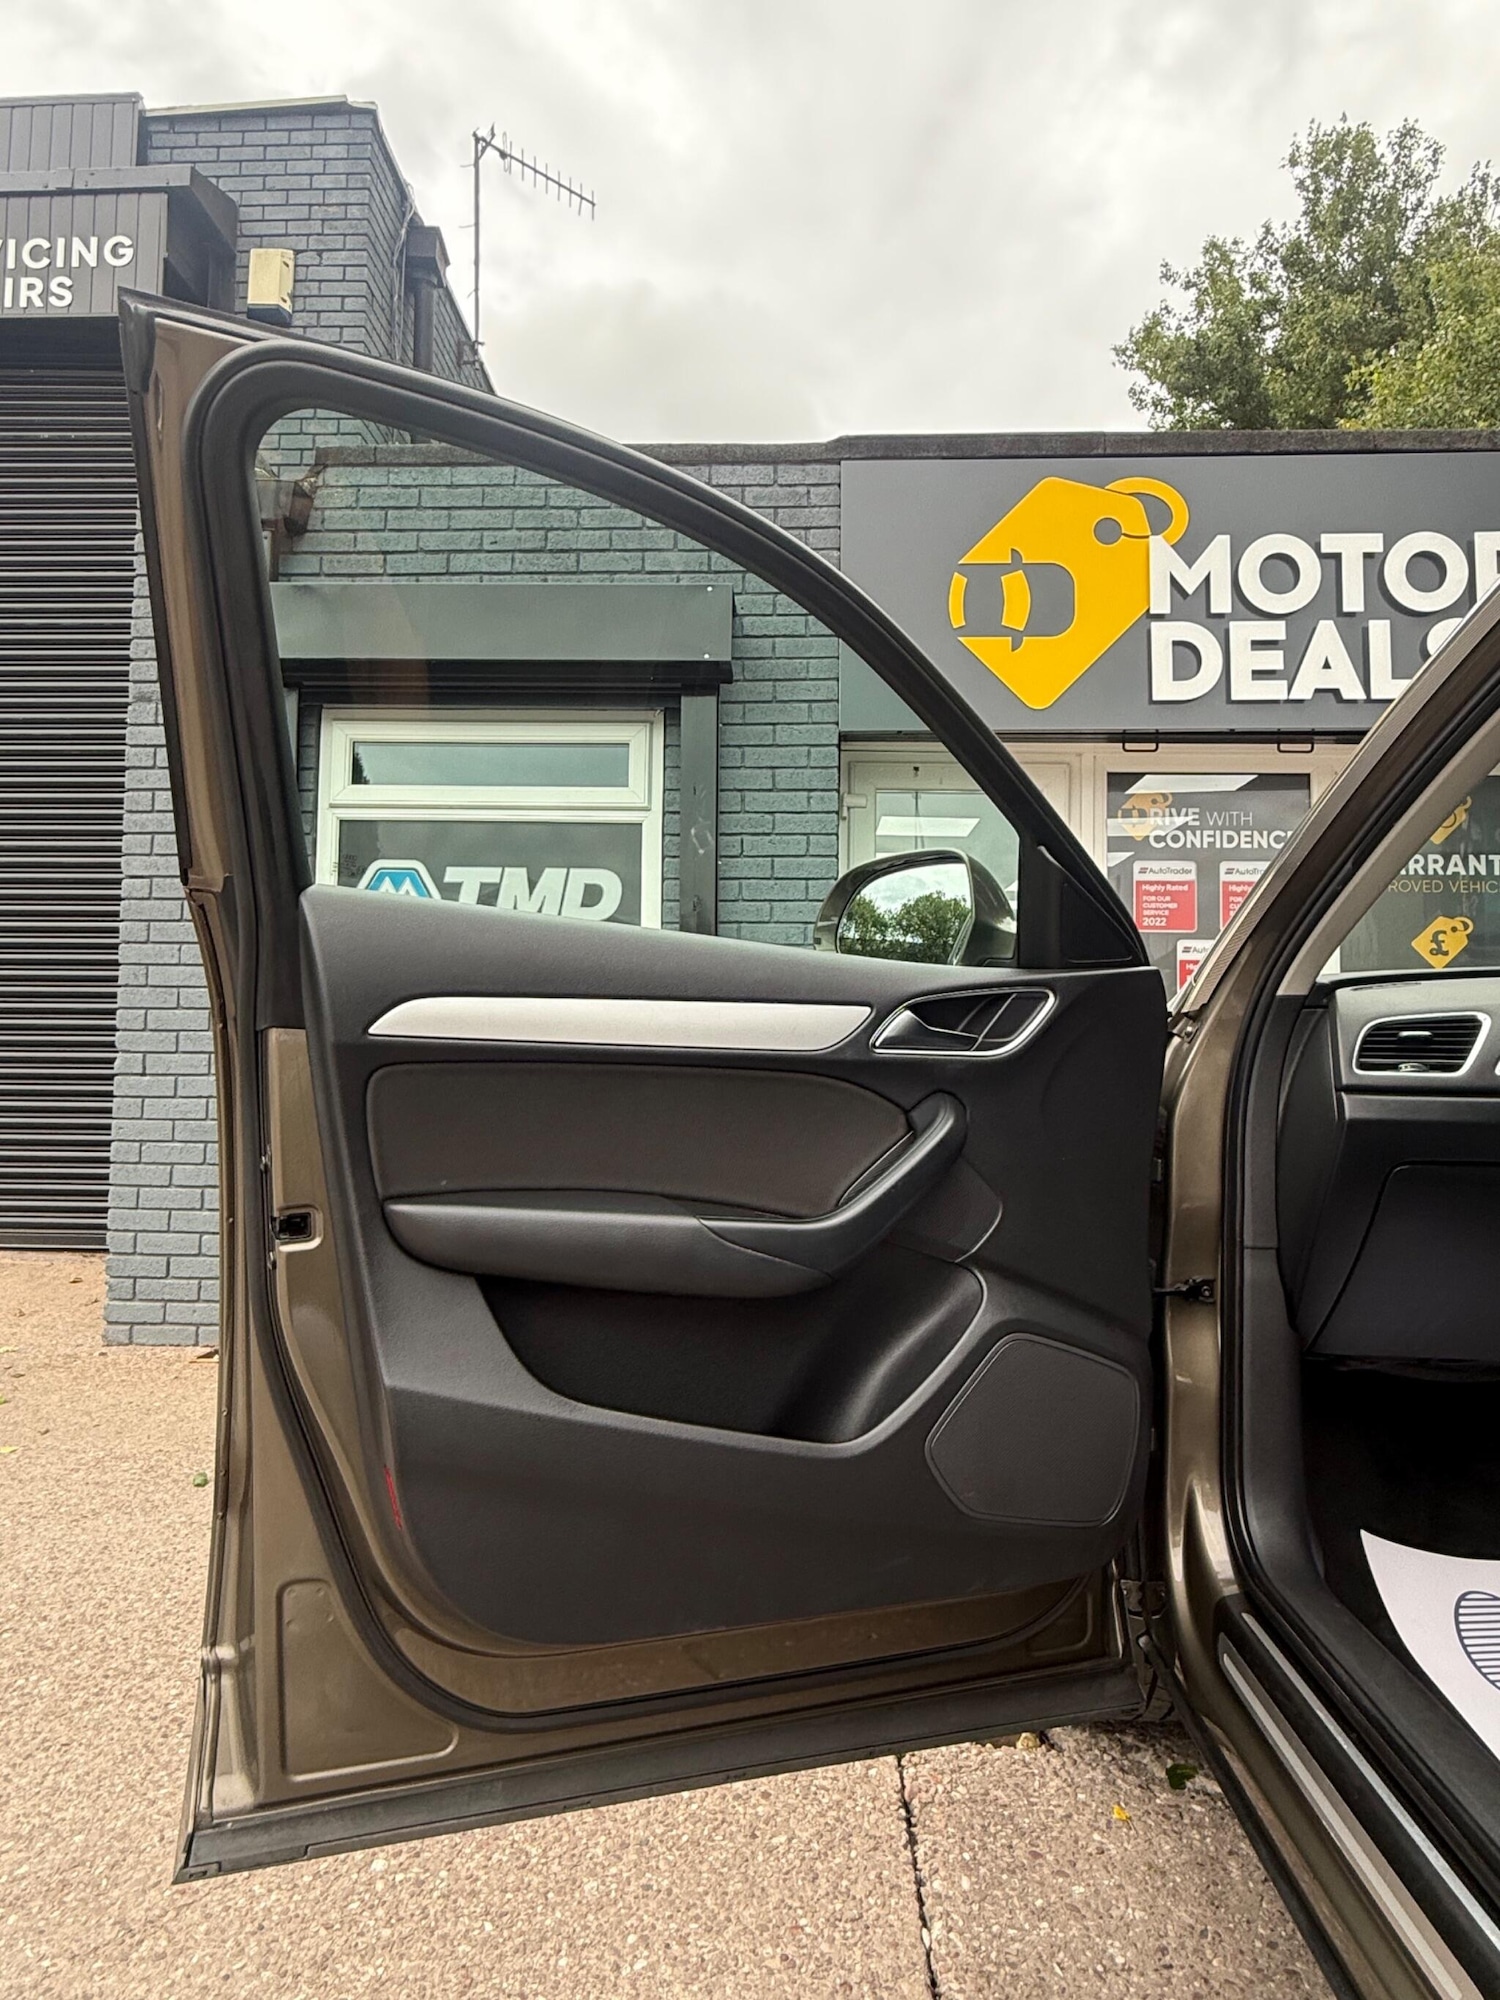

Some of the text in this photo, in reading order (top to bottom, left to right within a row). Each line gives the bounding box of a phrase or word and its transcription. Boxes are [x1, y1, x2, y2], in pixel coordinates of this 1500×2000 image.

[0, 235, 134, 269] ICING
[3, 276, 73, 308] IRS
[1206, 811, 1253, 826] WITH
[1149, 829, 1293, 849] CONFIDENC
[1148, 867, 1192, 875] AutoTrader
[1400, 854, 1500, 876] RRANT
[443, 867, 622, 921] TMD
[1142, 884, 1165, 893] Highly
[1449, 880, 1500, 893] VEHIC
[1142, 917, 1167, 926] 2022
